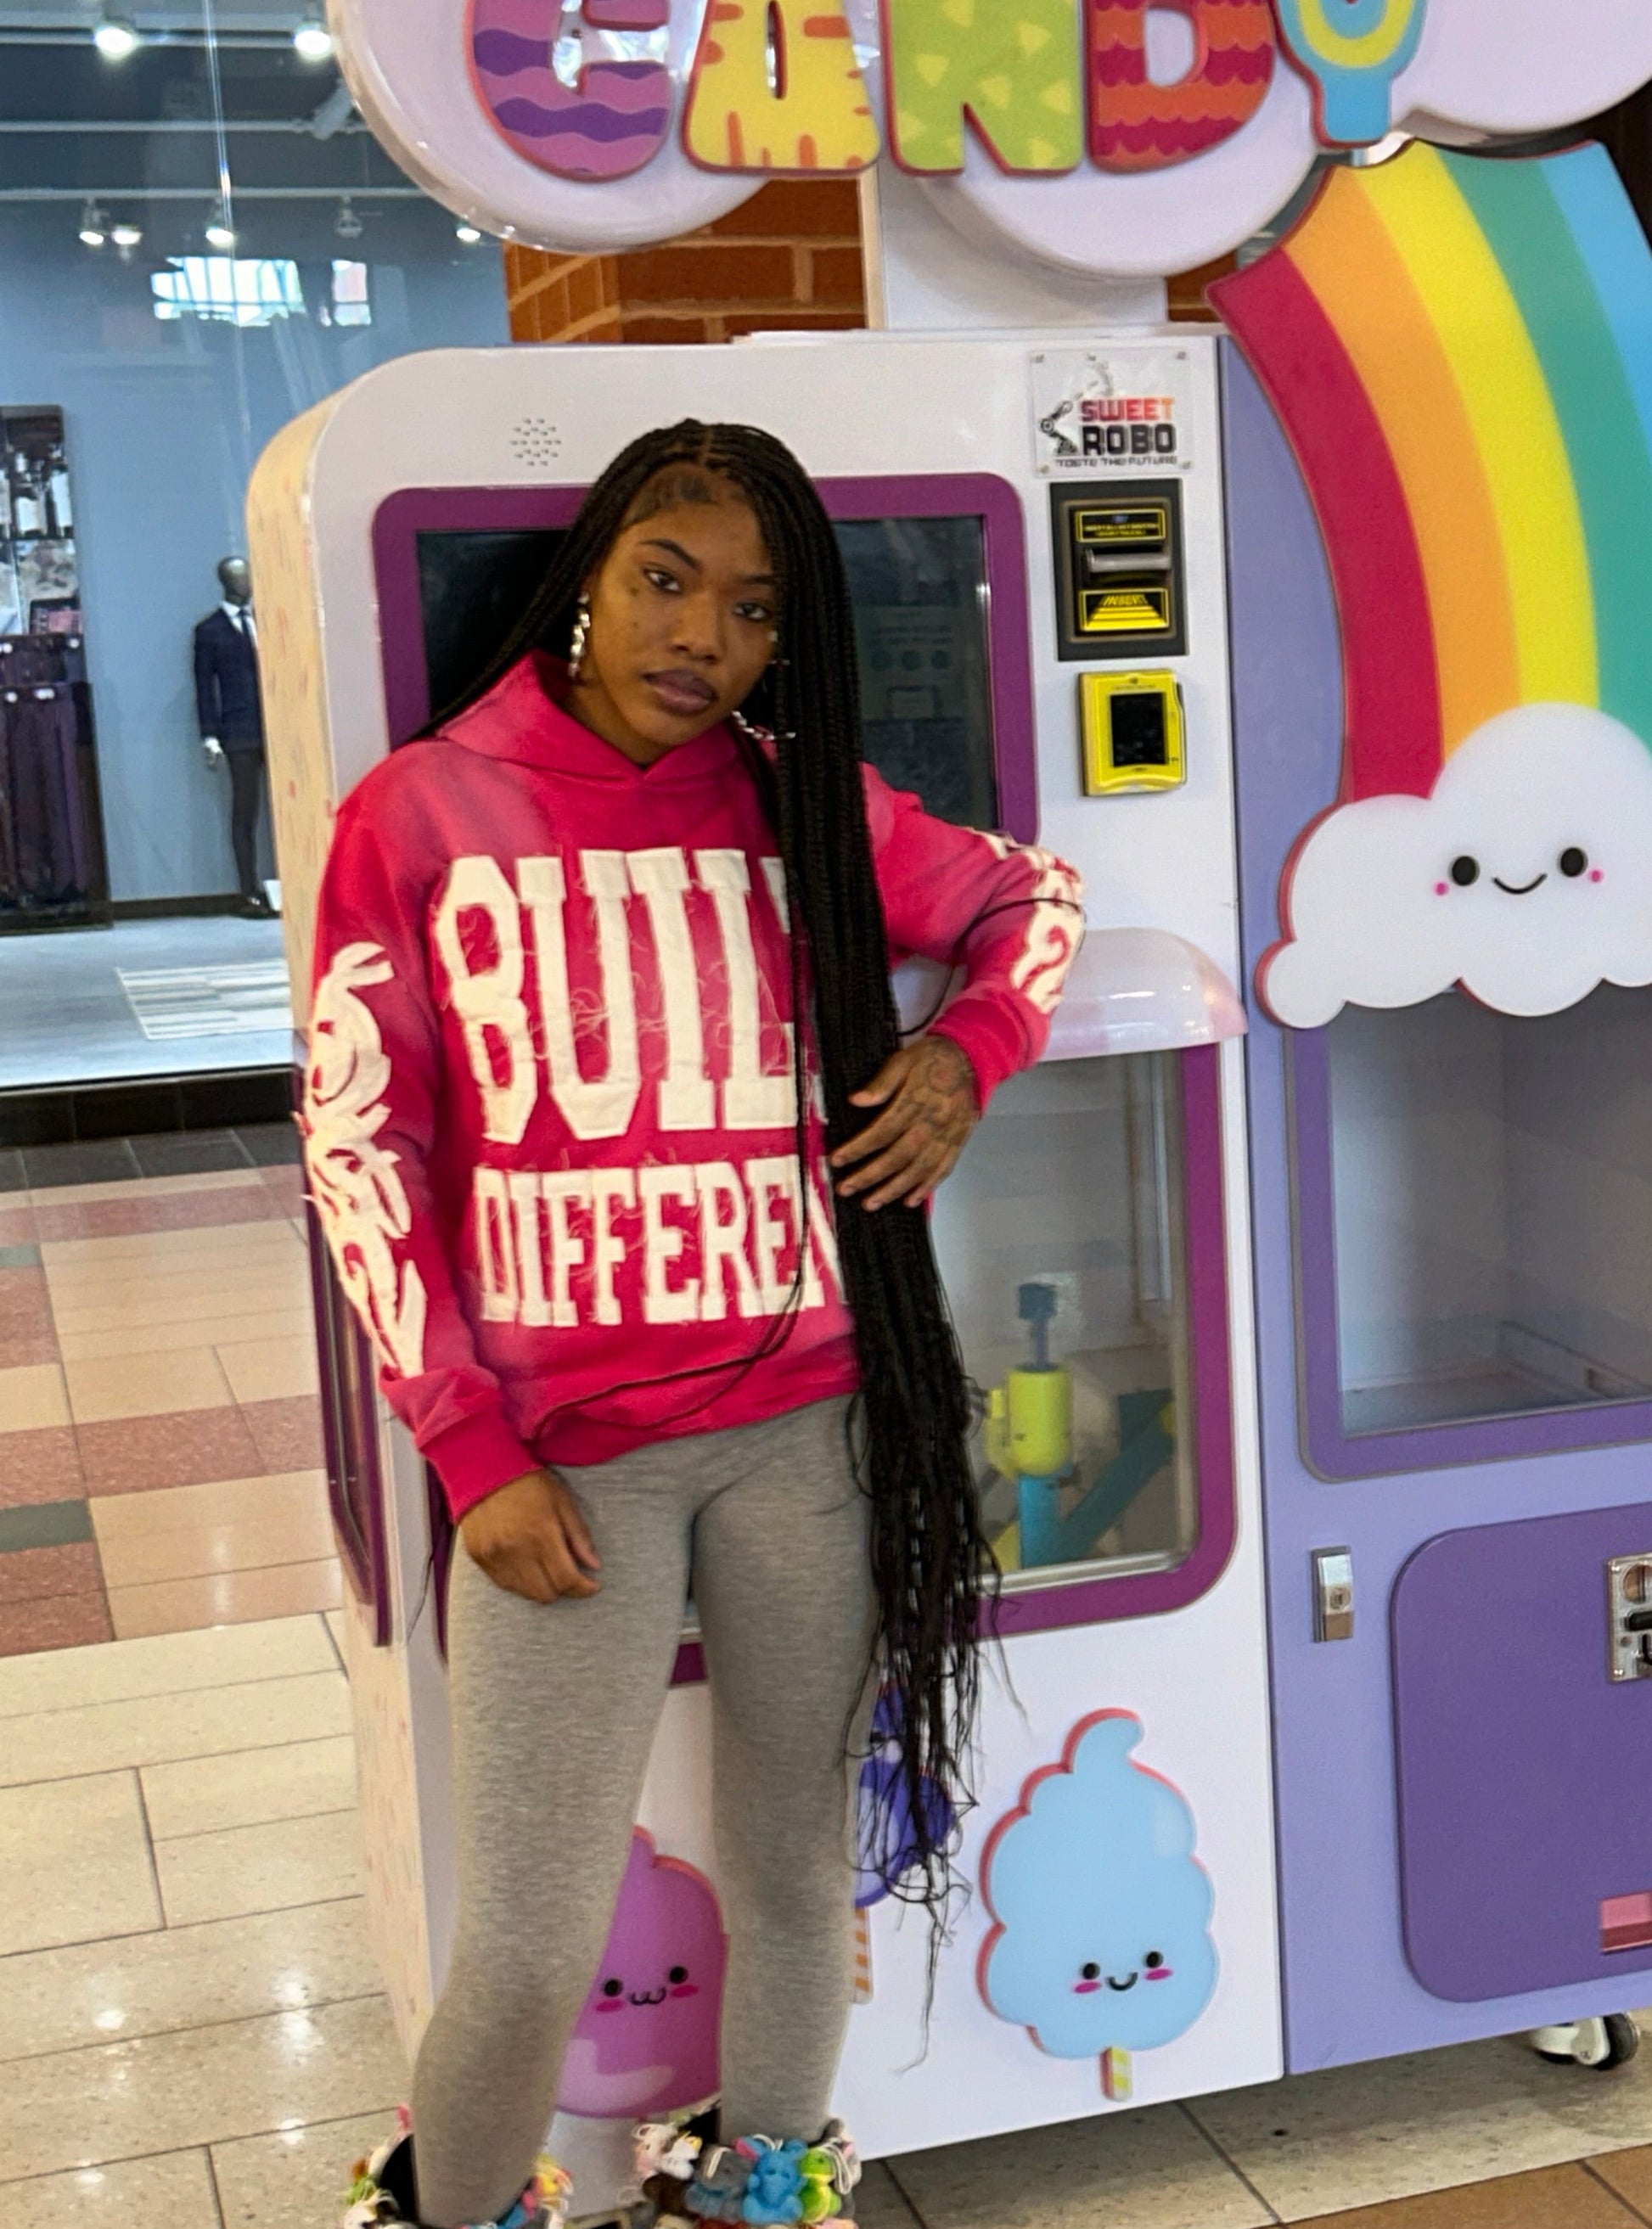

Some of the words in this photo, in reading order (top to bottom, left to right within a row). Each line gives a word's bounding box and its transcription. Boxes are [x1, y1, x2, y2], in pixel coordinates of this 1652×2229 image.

[1081, 396, 1175, 421] SWEET
[1082, 424, 1177, 456] ROBO
[434, 846, 829, 1145] BUIL
[472, 1154, 849, 1328] DIFFEREN
